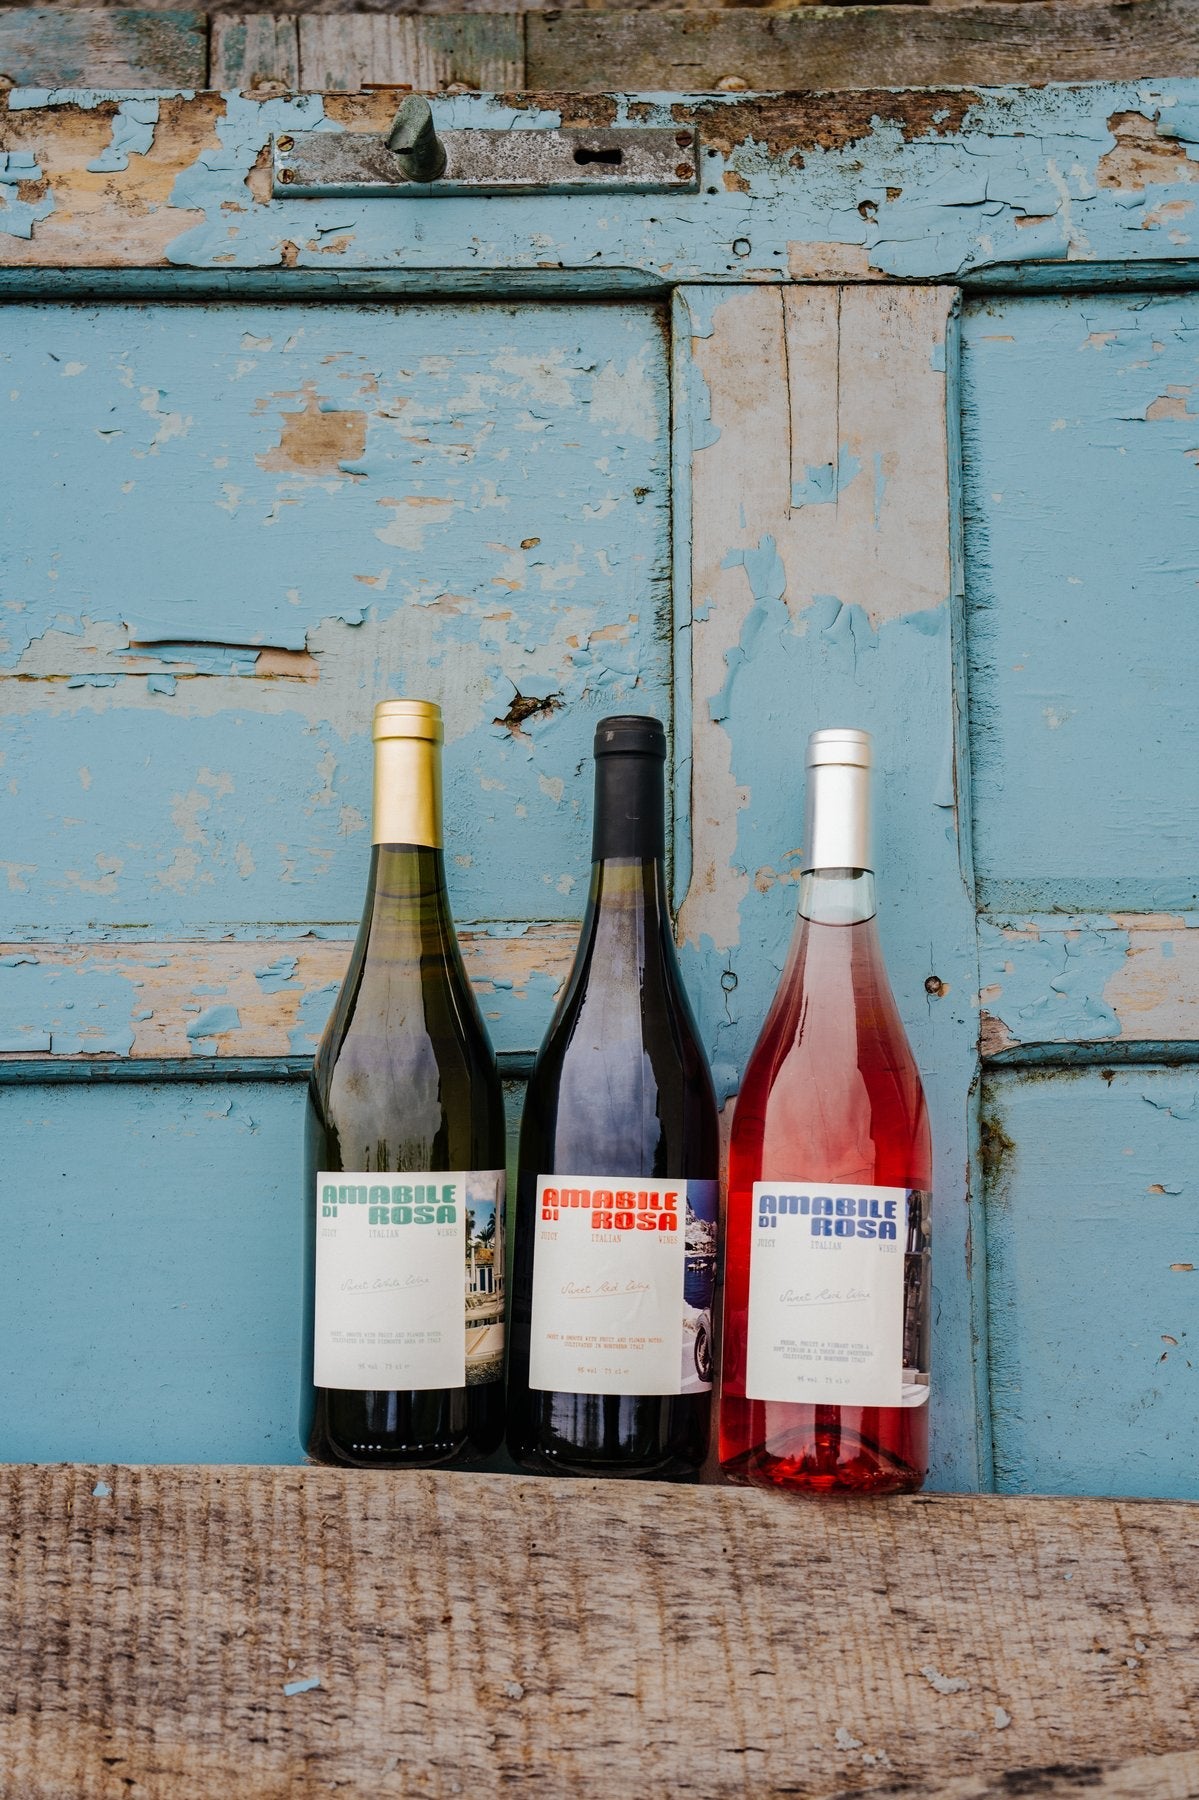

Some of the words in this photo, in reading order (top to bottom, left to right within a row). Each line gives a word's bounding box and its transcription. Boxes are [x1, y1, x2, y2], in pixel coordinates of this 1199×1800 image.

[322, 1184, 456, 1204] AMABILE
[542, 1188, 678, 1210] AMABILE
[322, 1205, 338, 1218] DI
[368, 1205, 456, 1225] ROSA
[759, 1195, 897, 1219] AMABILE
[541, 1208, 559, 1221] DI
[591, 1210, 677, 1231] ROSA
[758, 1215, 777, 1228] DI
[810, 1217, 897, 1240] ROSA
[368, 1229, 399, 1239] ITALIAN
[540, 1231, 559, 1241] JUICY
[591, 1233, 622, 1244] ITALIAN
[658, 1235, 678, 1245] WINES
[757, 1238, 776, 1248] JUICY
[810, 1240, 842, 1251] ITALIAN
[560, 1281, 592, 1295] Sweet
[779, 1289, 812, 1303] Sweet
